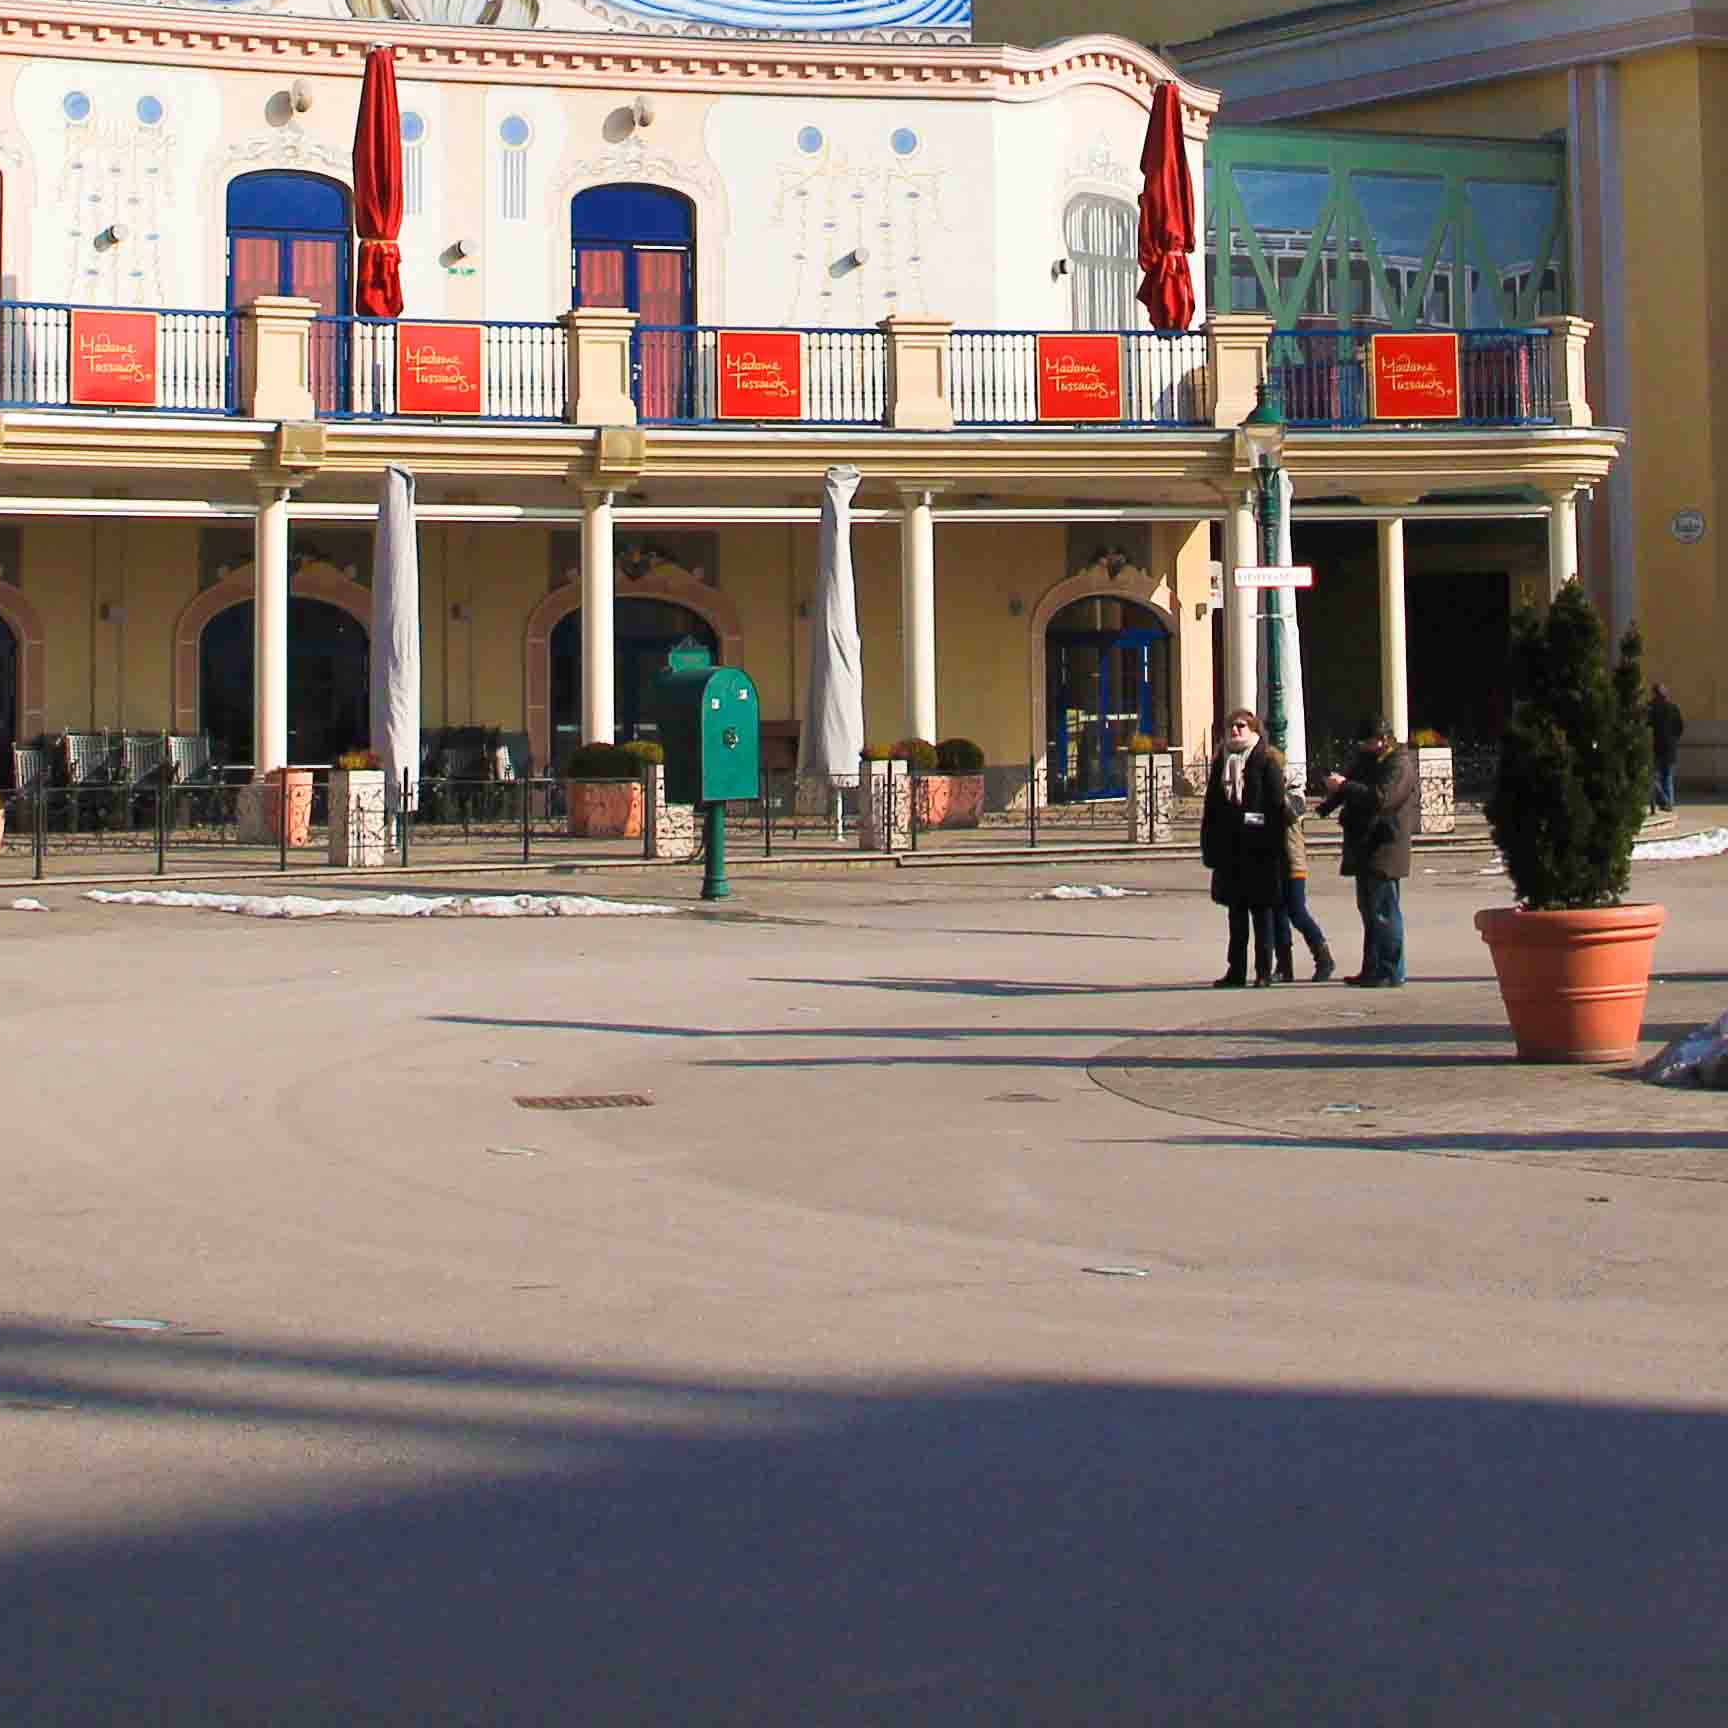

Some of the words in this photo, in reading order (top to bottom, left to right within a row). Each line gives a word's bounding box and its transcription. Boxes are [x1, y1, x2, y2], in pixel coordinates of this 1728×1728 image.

[79, 332, 138, 354] Madame
[405, 344, 464, 366] Madame
[726, 352, 784, 373] Madame
[1045, 354, 1102, 375] Madame
[727, 371, 791, 398] Tussauds
